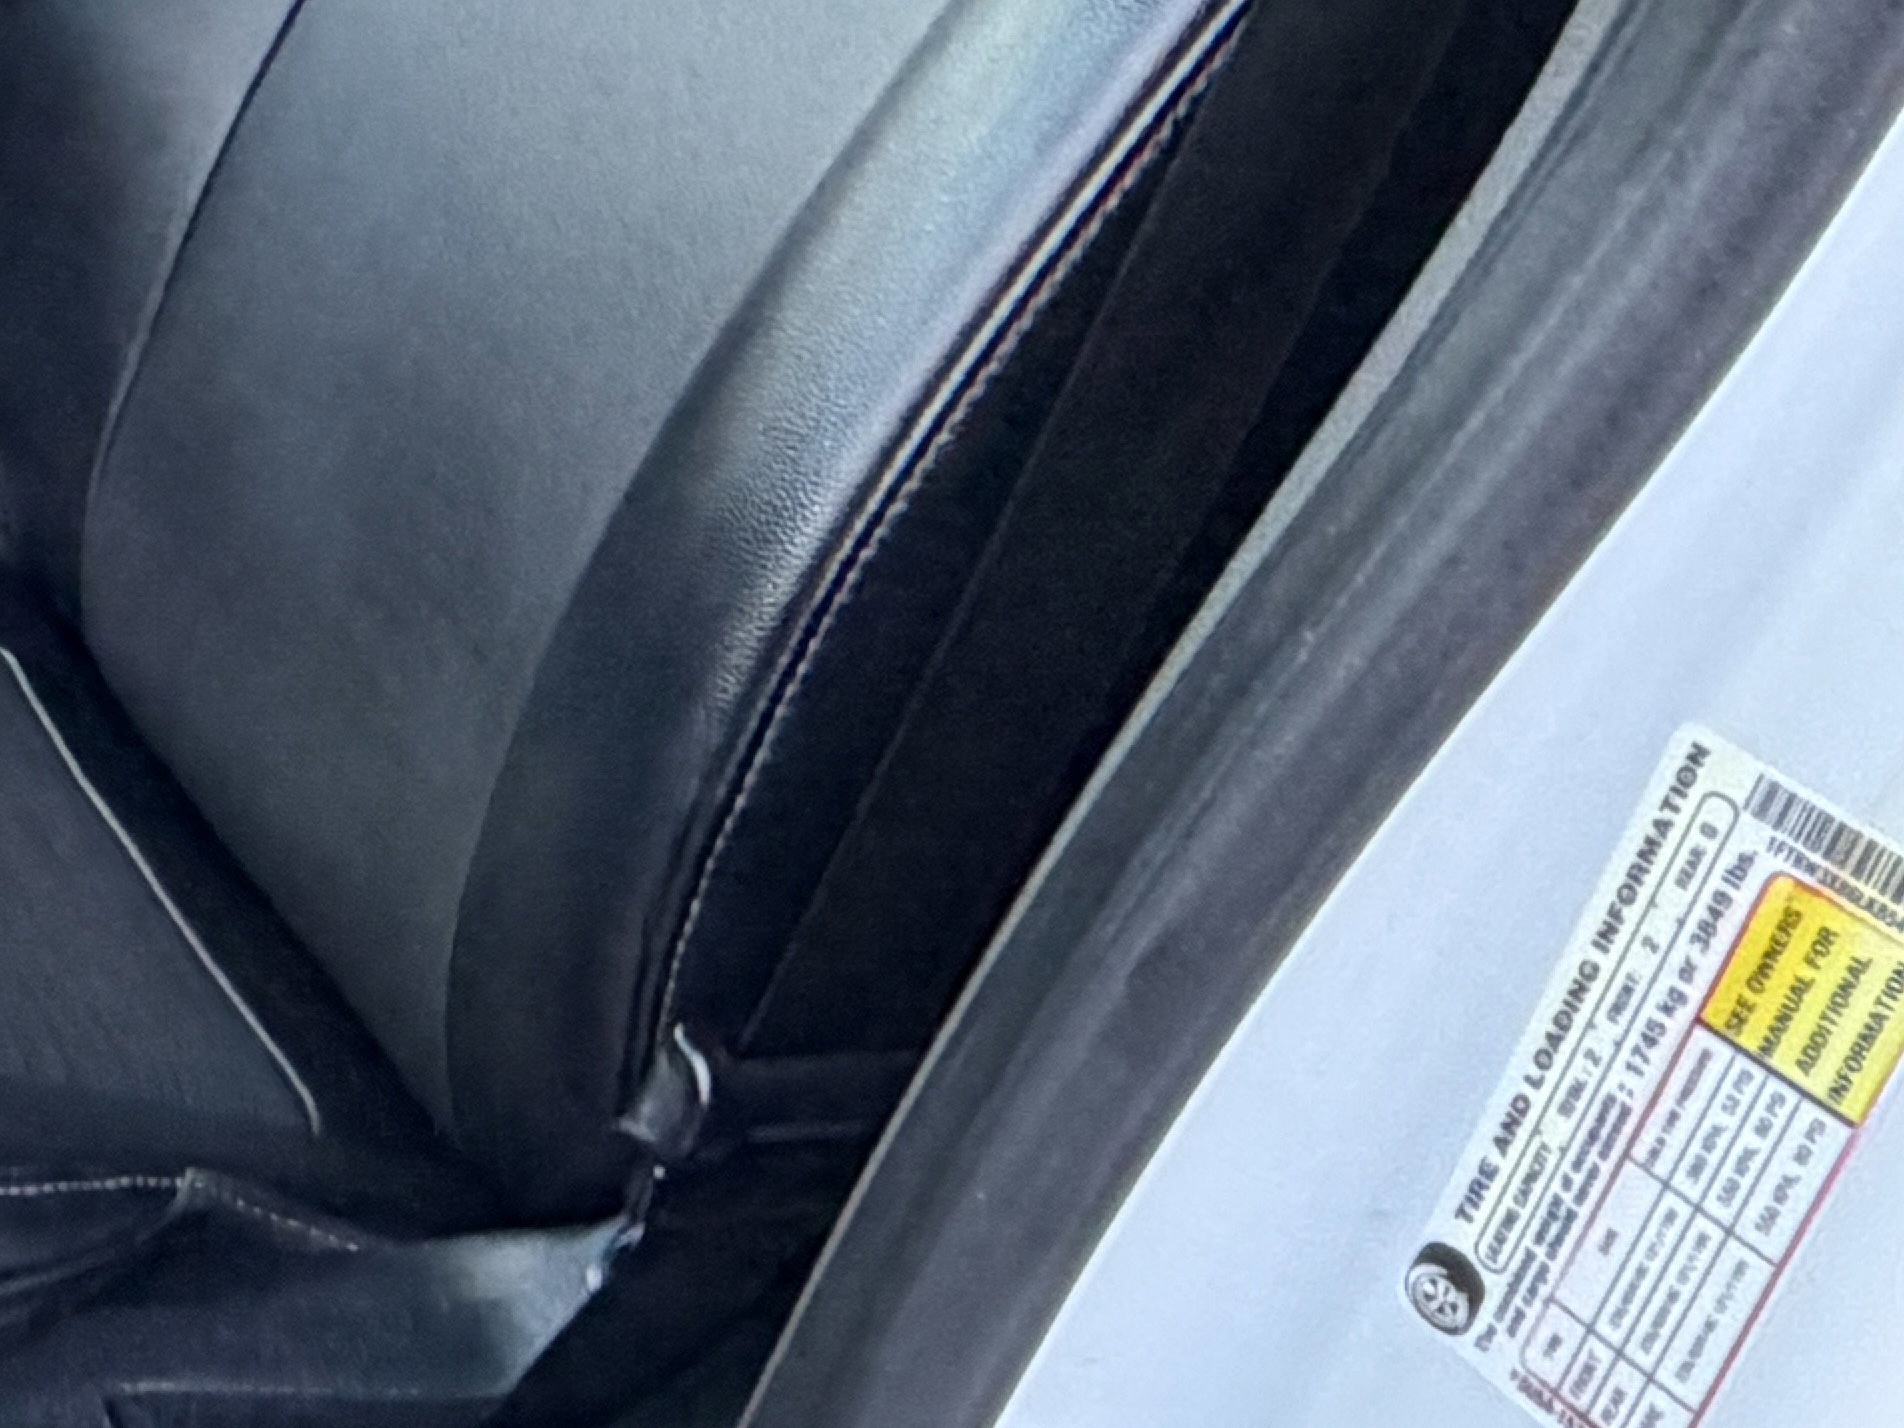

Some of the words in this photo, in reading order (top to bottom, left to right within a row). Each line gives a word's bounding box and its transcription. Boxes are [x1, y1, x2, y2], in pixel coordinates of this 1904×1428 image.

[1455, 1157, 1499, 1223] TIRE
[1493, 1093, 1531, 1158] AND
[1523, 960, 1599, 1090] LOADING
[1591, 741, 1711, 954] INFORMATION
[1583, 1048, 1602, 1068] 2
[1641, 935, 1659, 954] 2
[1625, 1017, 1667, 1077] 1745
[1655, 985, 1688, 1017] kg
[1678, 955, 1697, 984] or
[1689, 889, 1733, 954] 3849
[1721, 851, 1758, 891] lbs.
[1724, 994, 1756, 1035] SEE
[1757, 974, 1815, 1058] MANUAL
[1803, 925, 1839, 970] FOR
[1795, 956, 1873, 1077] ADDITIONAL
